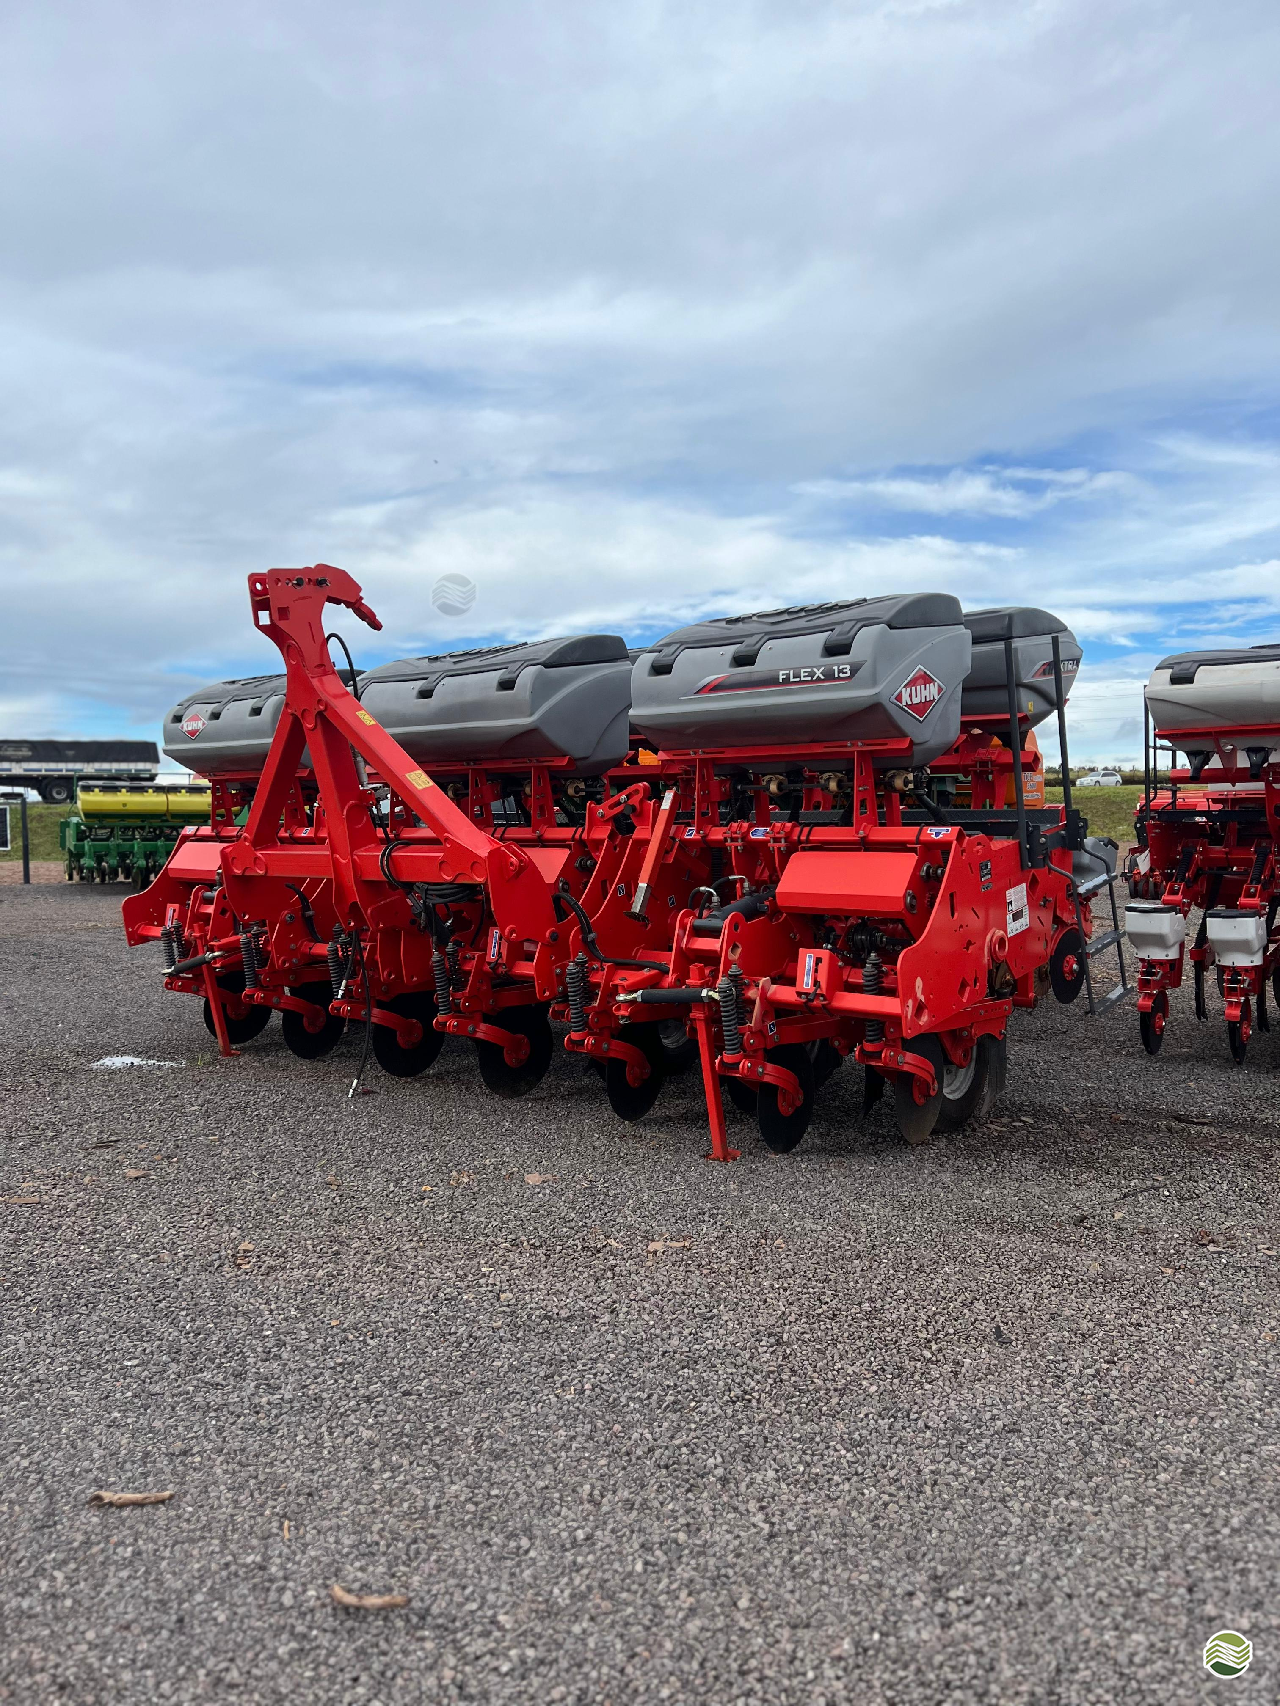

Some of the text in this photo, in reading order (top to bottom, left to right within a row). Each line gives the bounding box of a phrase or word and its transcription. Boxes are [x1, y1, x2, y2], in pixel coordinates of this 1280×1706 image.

[778, 664, 851, 683] FLEX 13
[901, 681, 938, 706] KUHN
[183, 720, 203, 731] KUHN
